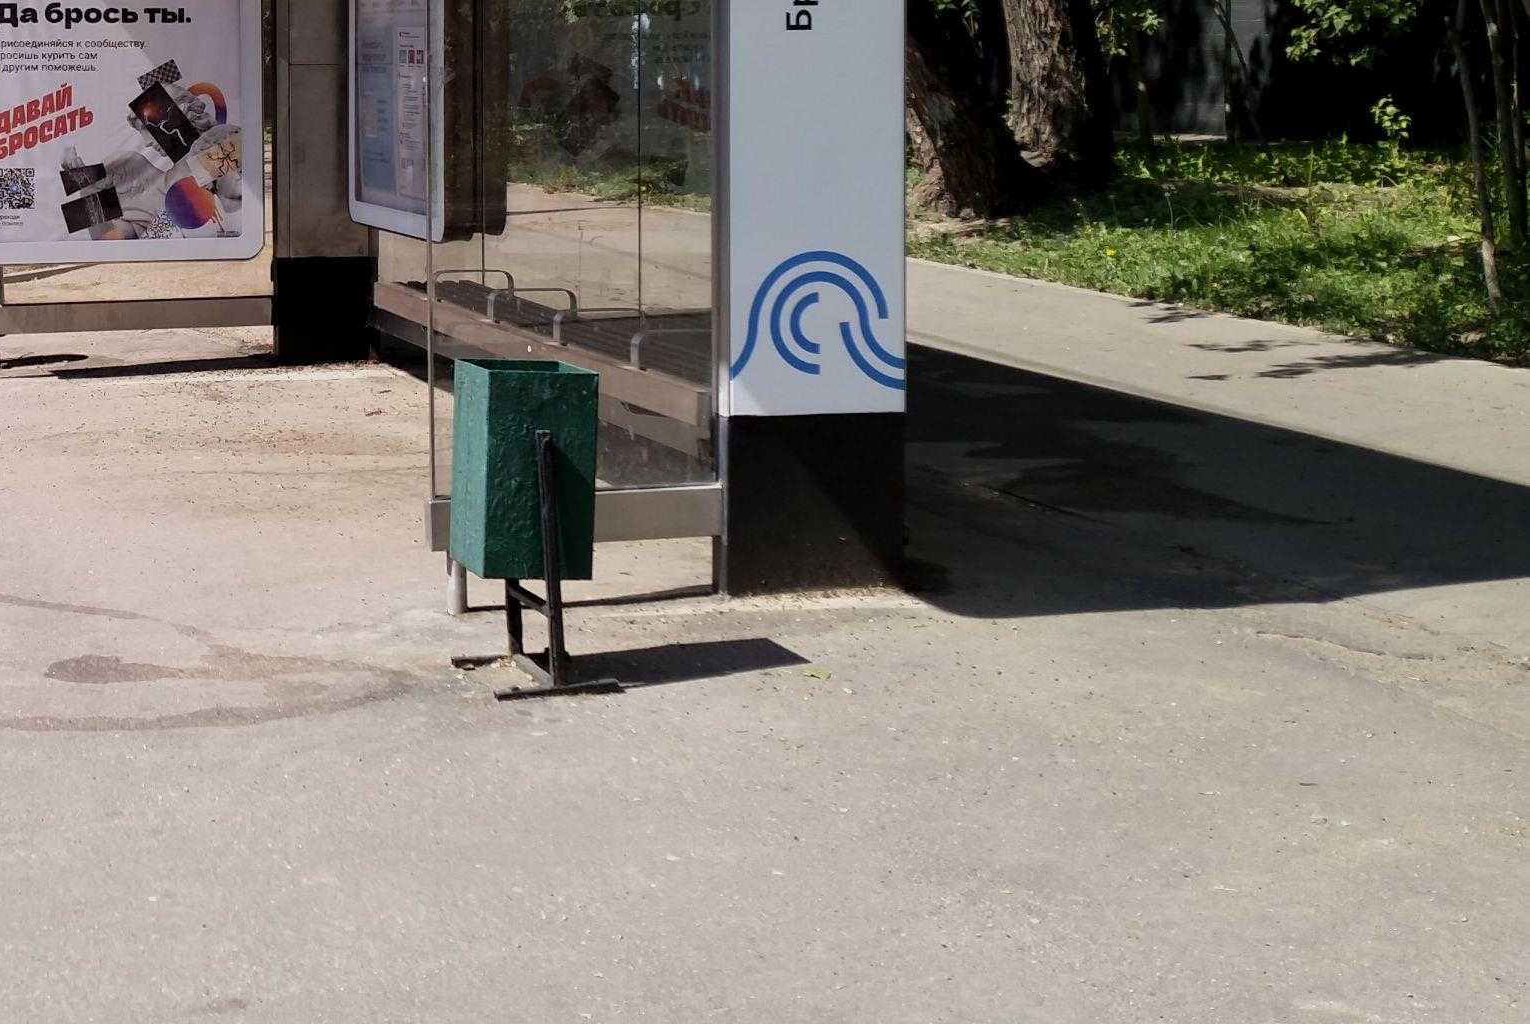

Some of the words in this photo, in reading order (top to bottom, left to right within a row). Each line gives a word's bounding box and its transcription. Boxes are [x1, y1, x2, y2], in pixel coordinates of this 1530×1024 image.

[44, 2, 139, 29] брось
[143, 6, 192, 24] ты.
[41, 52, 76, 62] курить
[2, 65, 39, 74] другим
